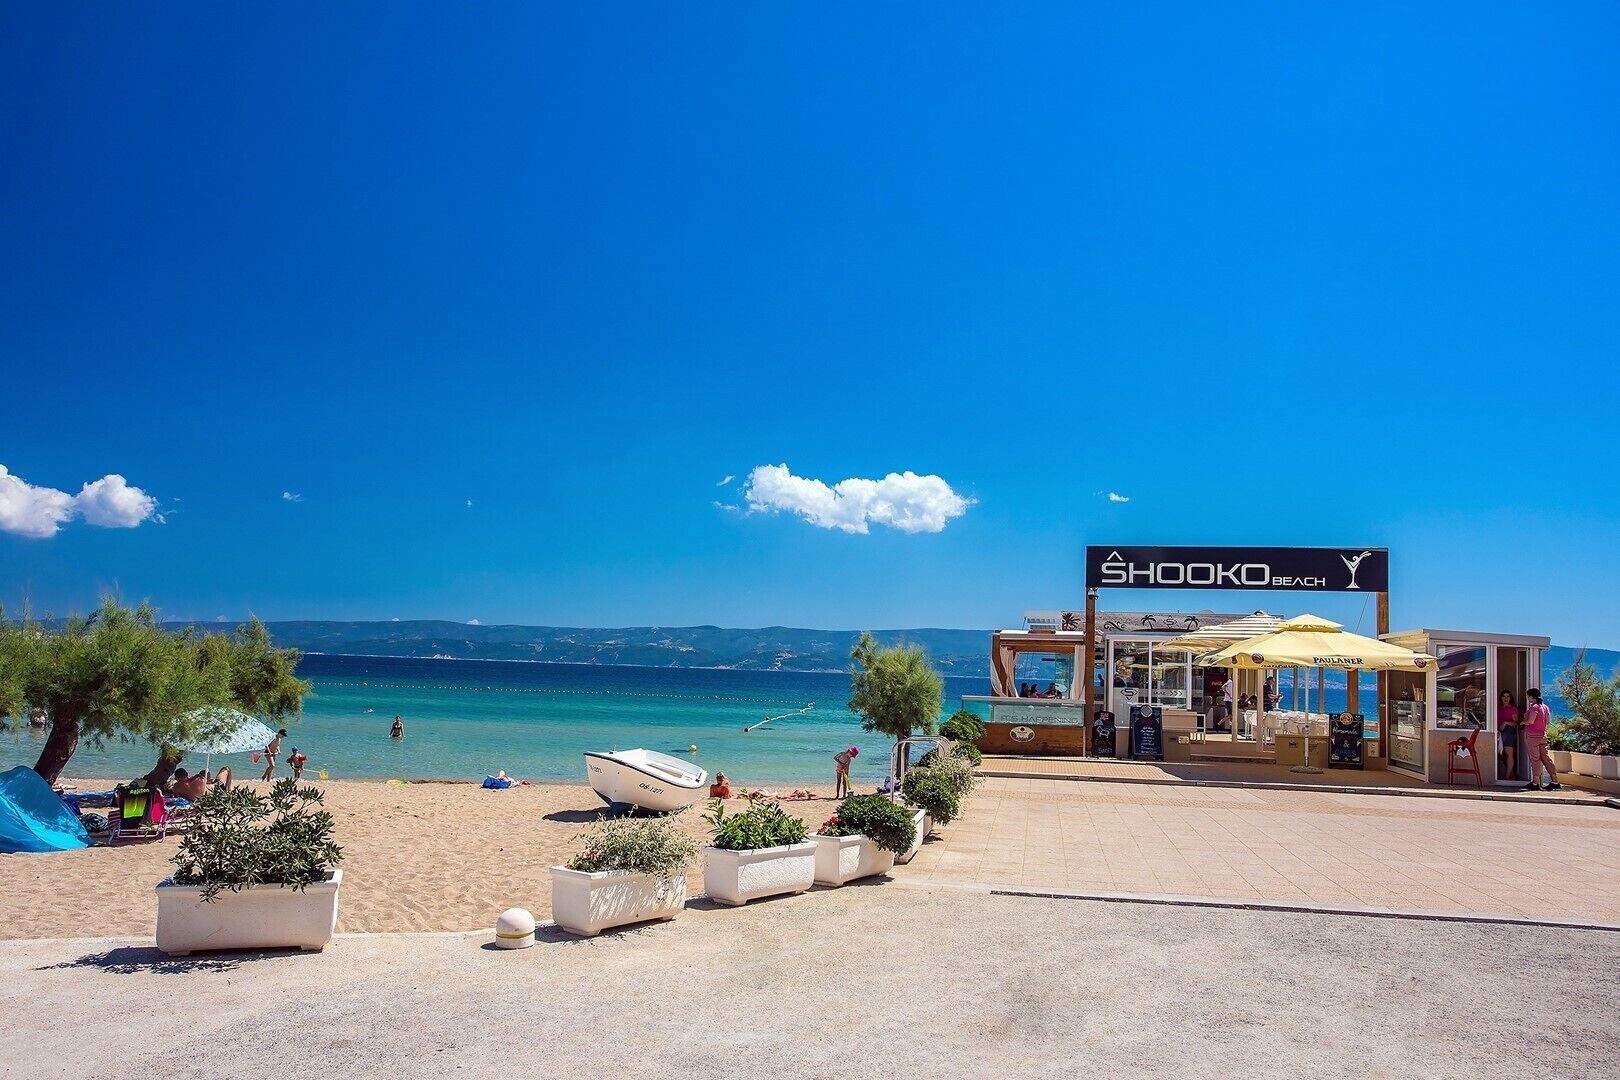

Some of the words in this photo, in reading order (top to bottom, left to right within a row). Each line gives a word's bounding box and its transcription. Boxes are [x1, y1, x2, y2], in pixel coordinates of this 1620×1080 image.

[1272, 577, 1326, 586] BEACH
[1313, 656, 1364, 665] PAULANER
[1021, 716, 1079, 724] HAPPENING
